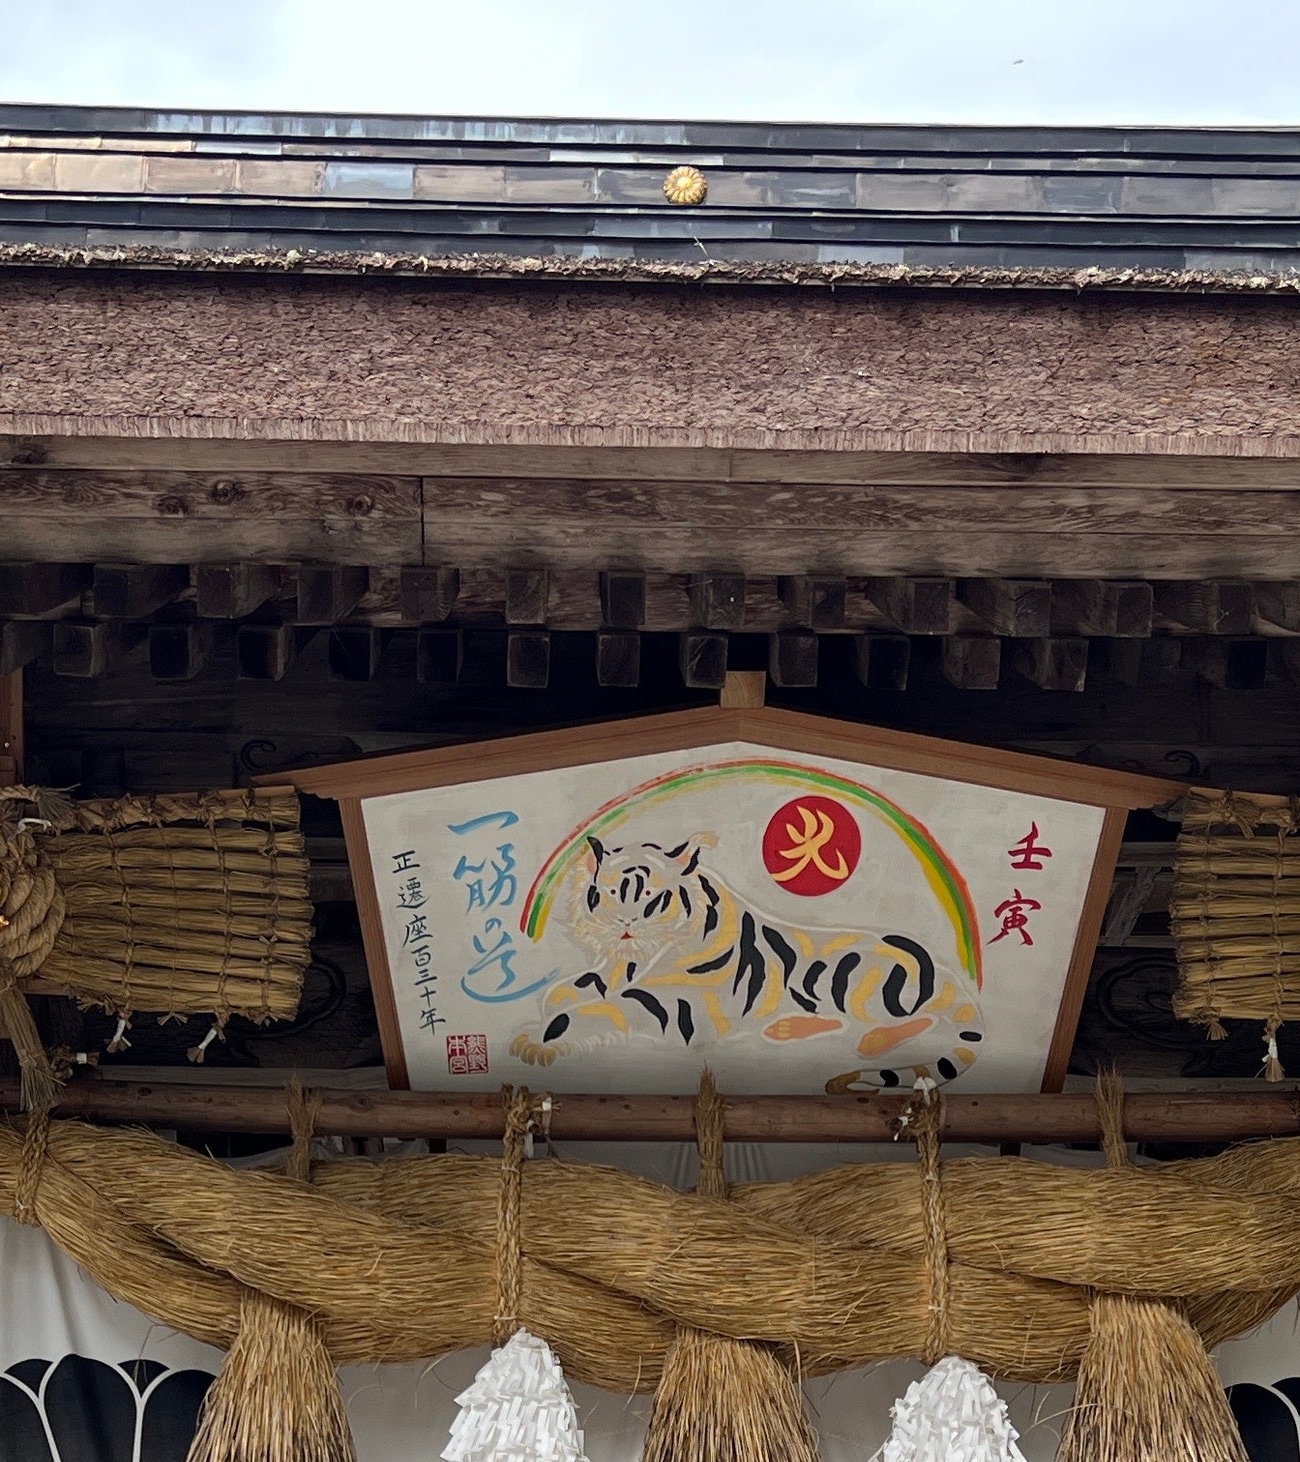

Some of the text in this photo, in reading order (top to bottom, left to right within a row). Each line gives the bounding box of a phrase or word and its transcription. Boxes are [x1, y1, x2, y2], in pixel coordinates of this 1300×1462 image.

[391, 849, 446, 1037] 正遷座百三十年
[986, 821, 1053, 947] 壬寅
